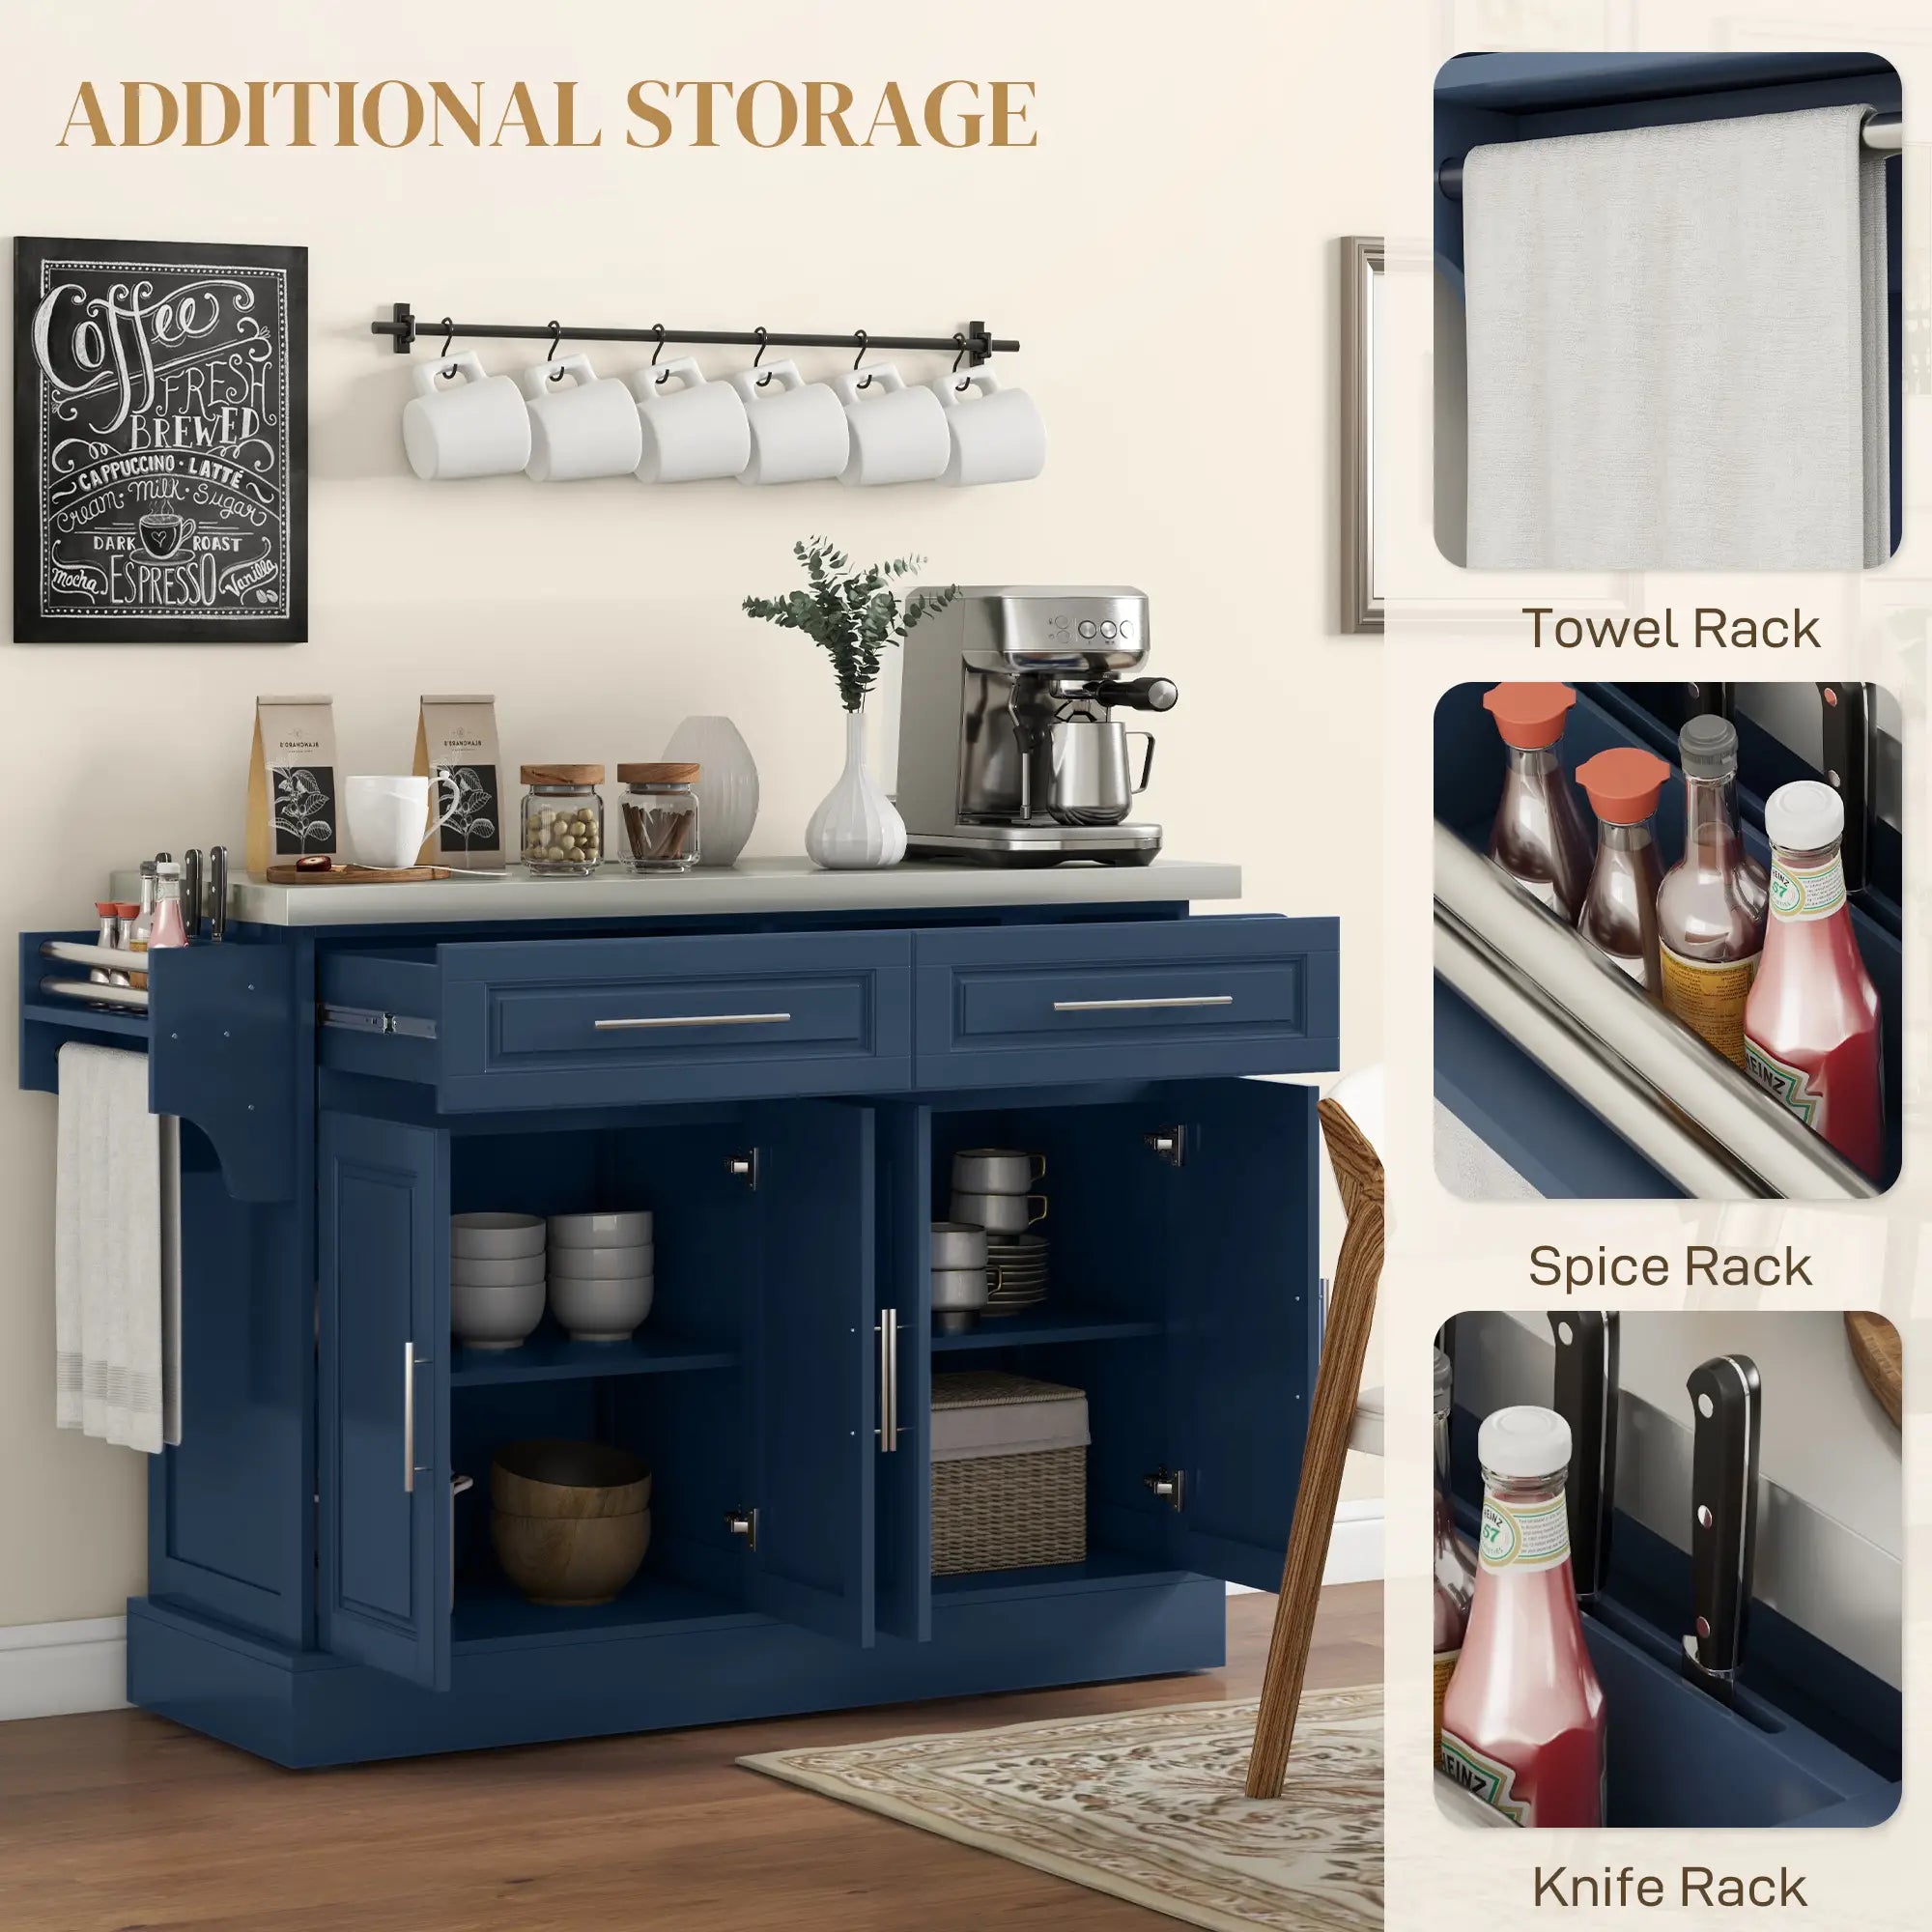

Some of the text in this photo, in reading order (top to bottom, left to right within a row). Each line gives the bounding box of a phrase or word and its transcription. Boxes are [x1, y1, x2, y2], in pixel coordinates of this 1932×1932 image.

[32, 280, 255, 435] Coffee
[155, 354, 278, 426] FRESH
[129, 406, 260, 452] BREWED
[78, 454, 175, 492] CAPPUCCINO
[57, 490, 124, 533] Cream
[193, 483, 268, 526] Sugar
[94, 535, 243, 553] DARK ROAST
[109, 553, 216, 606] ESPRESSO
[224, 558, 278, 597] Vanilla
[1773, 881, 1788, 897] 57
[1482, 1523, 1500, 1543] 57
